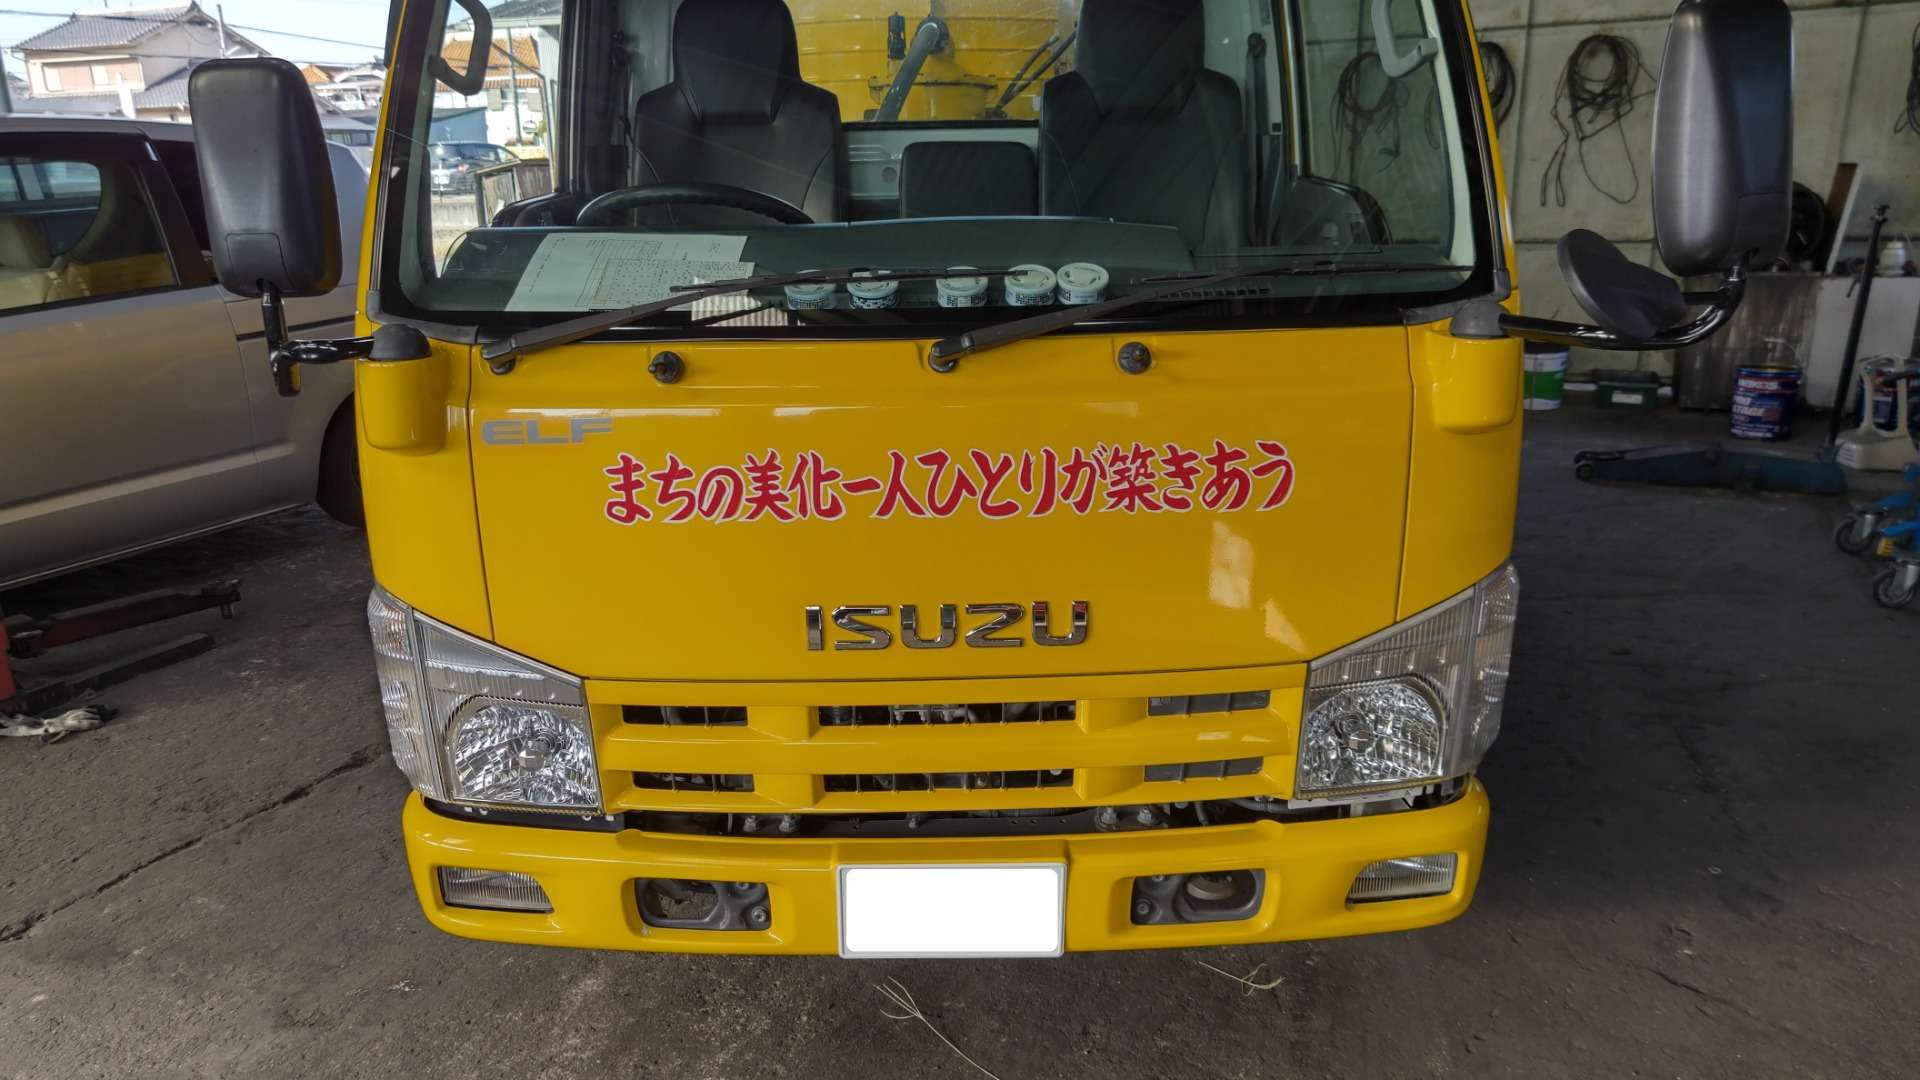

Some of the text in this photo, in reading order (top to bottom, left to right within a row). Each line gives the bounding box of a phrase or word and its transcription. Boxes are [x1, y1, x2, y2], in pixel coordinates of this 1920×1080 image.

[482, 417, 612, 445] ELF
[603, 439, 1296, 525] まちの美化一人ひとりが築きあう
[804, 599, 1090, 651] ISUZU
